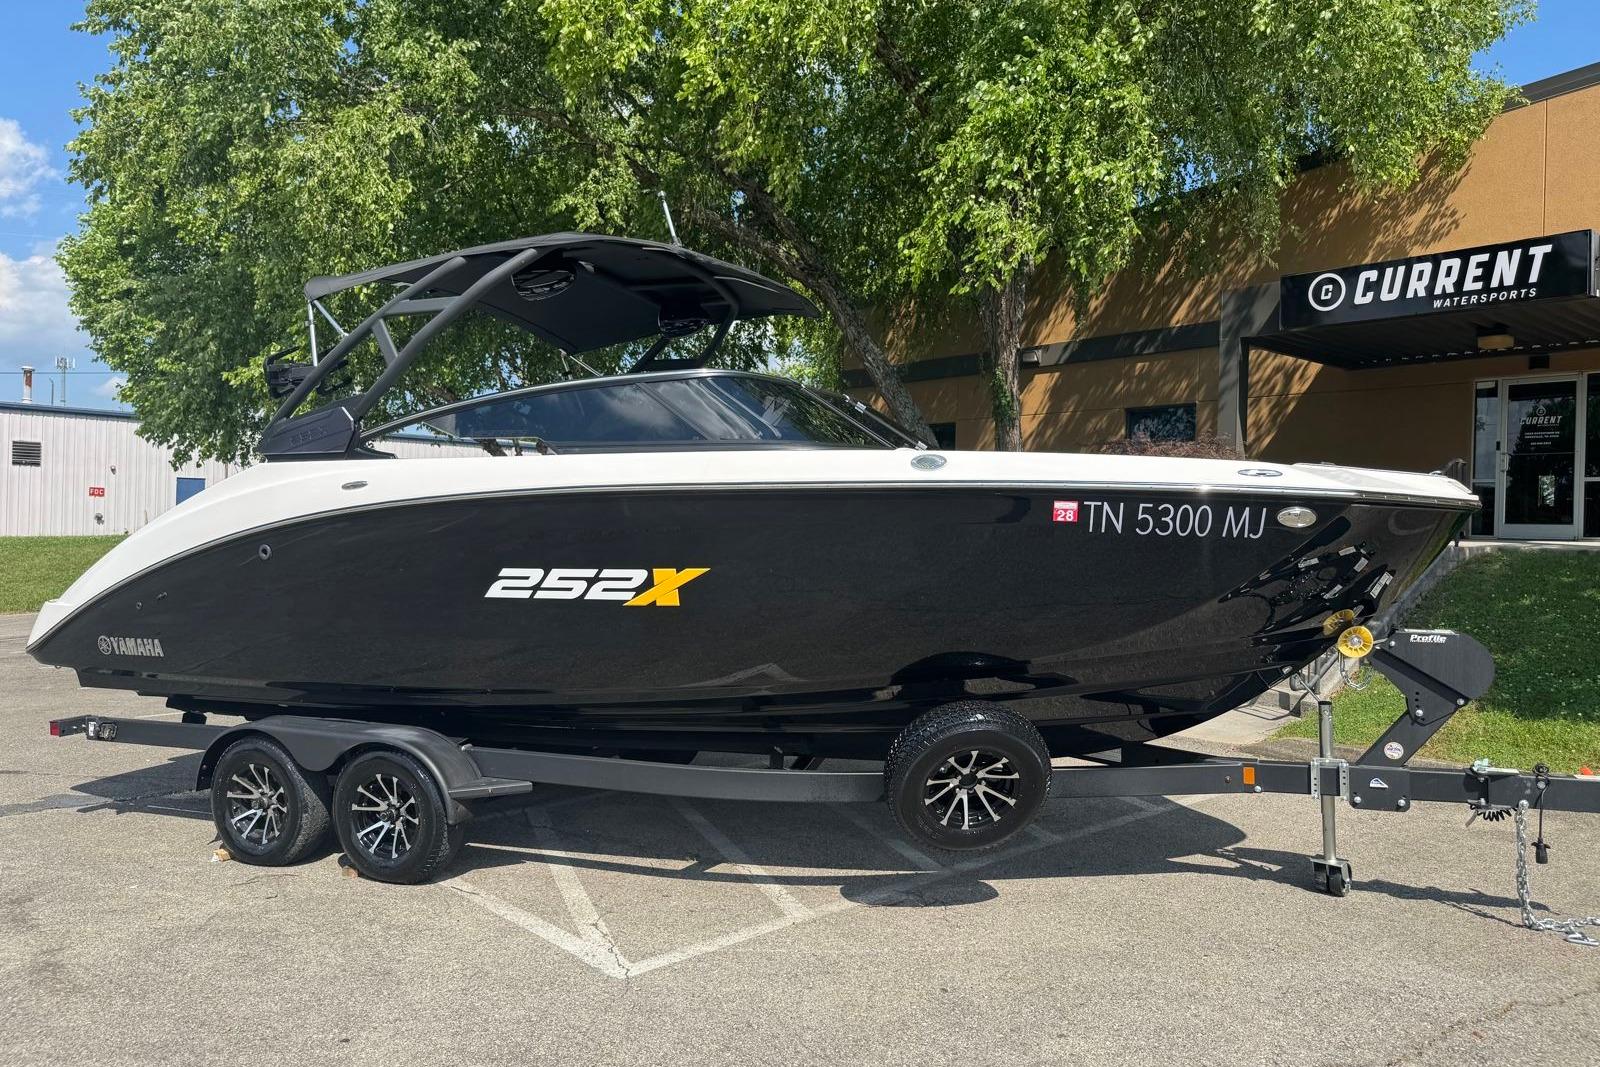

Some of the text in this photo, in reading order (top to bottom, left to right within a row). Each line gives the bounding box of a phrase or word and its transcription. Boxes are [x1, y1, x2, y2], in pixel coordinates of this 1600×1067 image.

[1353, 244, 1553, 305] CURRENT
[1433, 287, 1537, 309] WATERSPORTS
[1519, 415, 1562, 424] CURRENT
[1056, 509, 1074, 522] 28
[1083, 501, 1267, 539] TN 5300 MJ
[484, 567, 711, 606] 252X
[109, 636, 164, 657] YAMAHA
[1410, 634, 1447, 643] Profile
